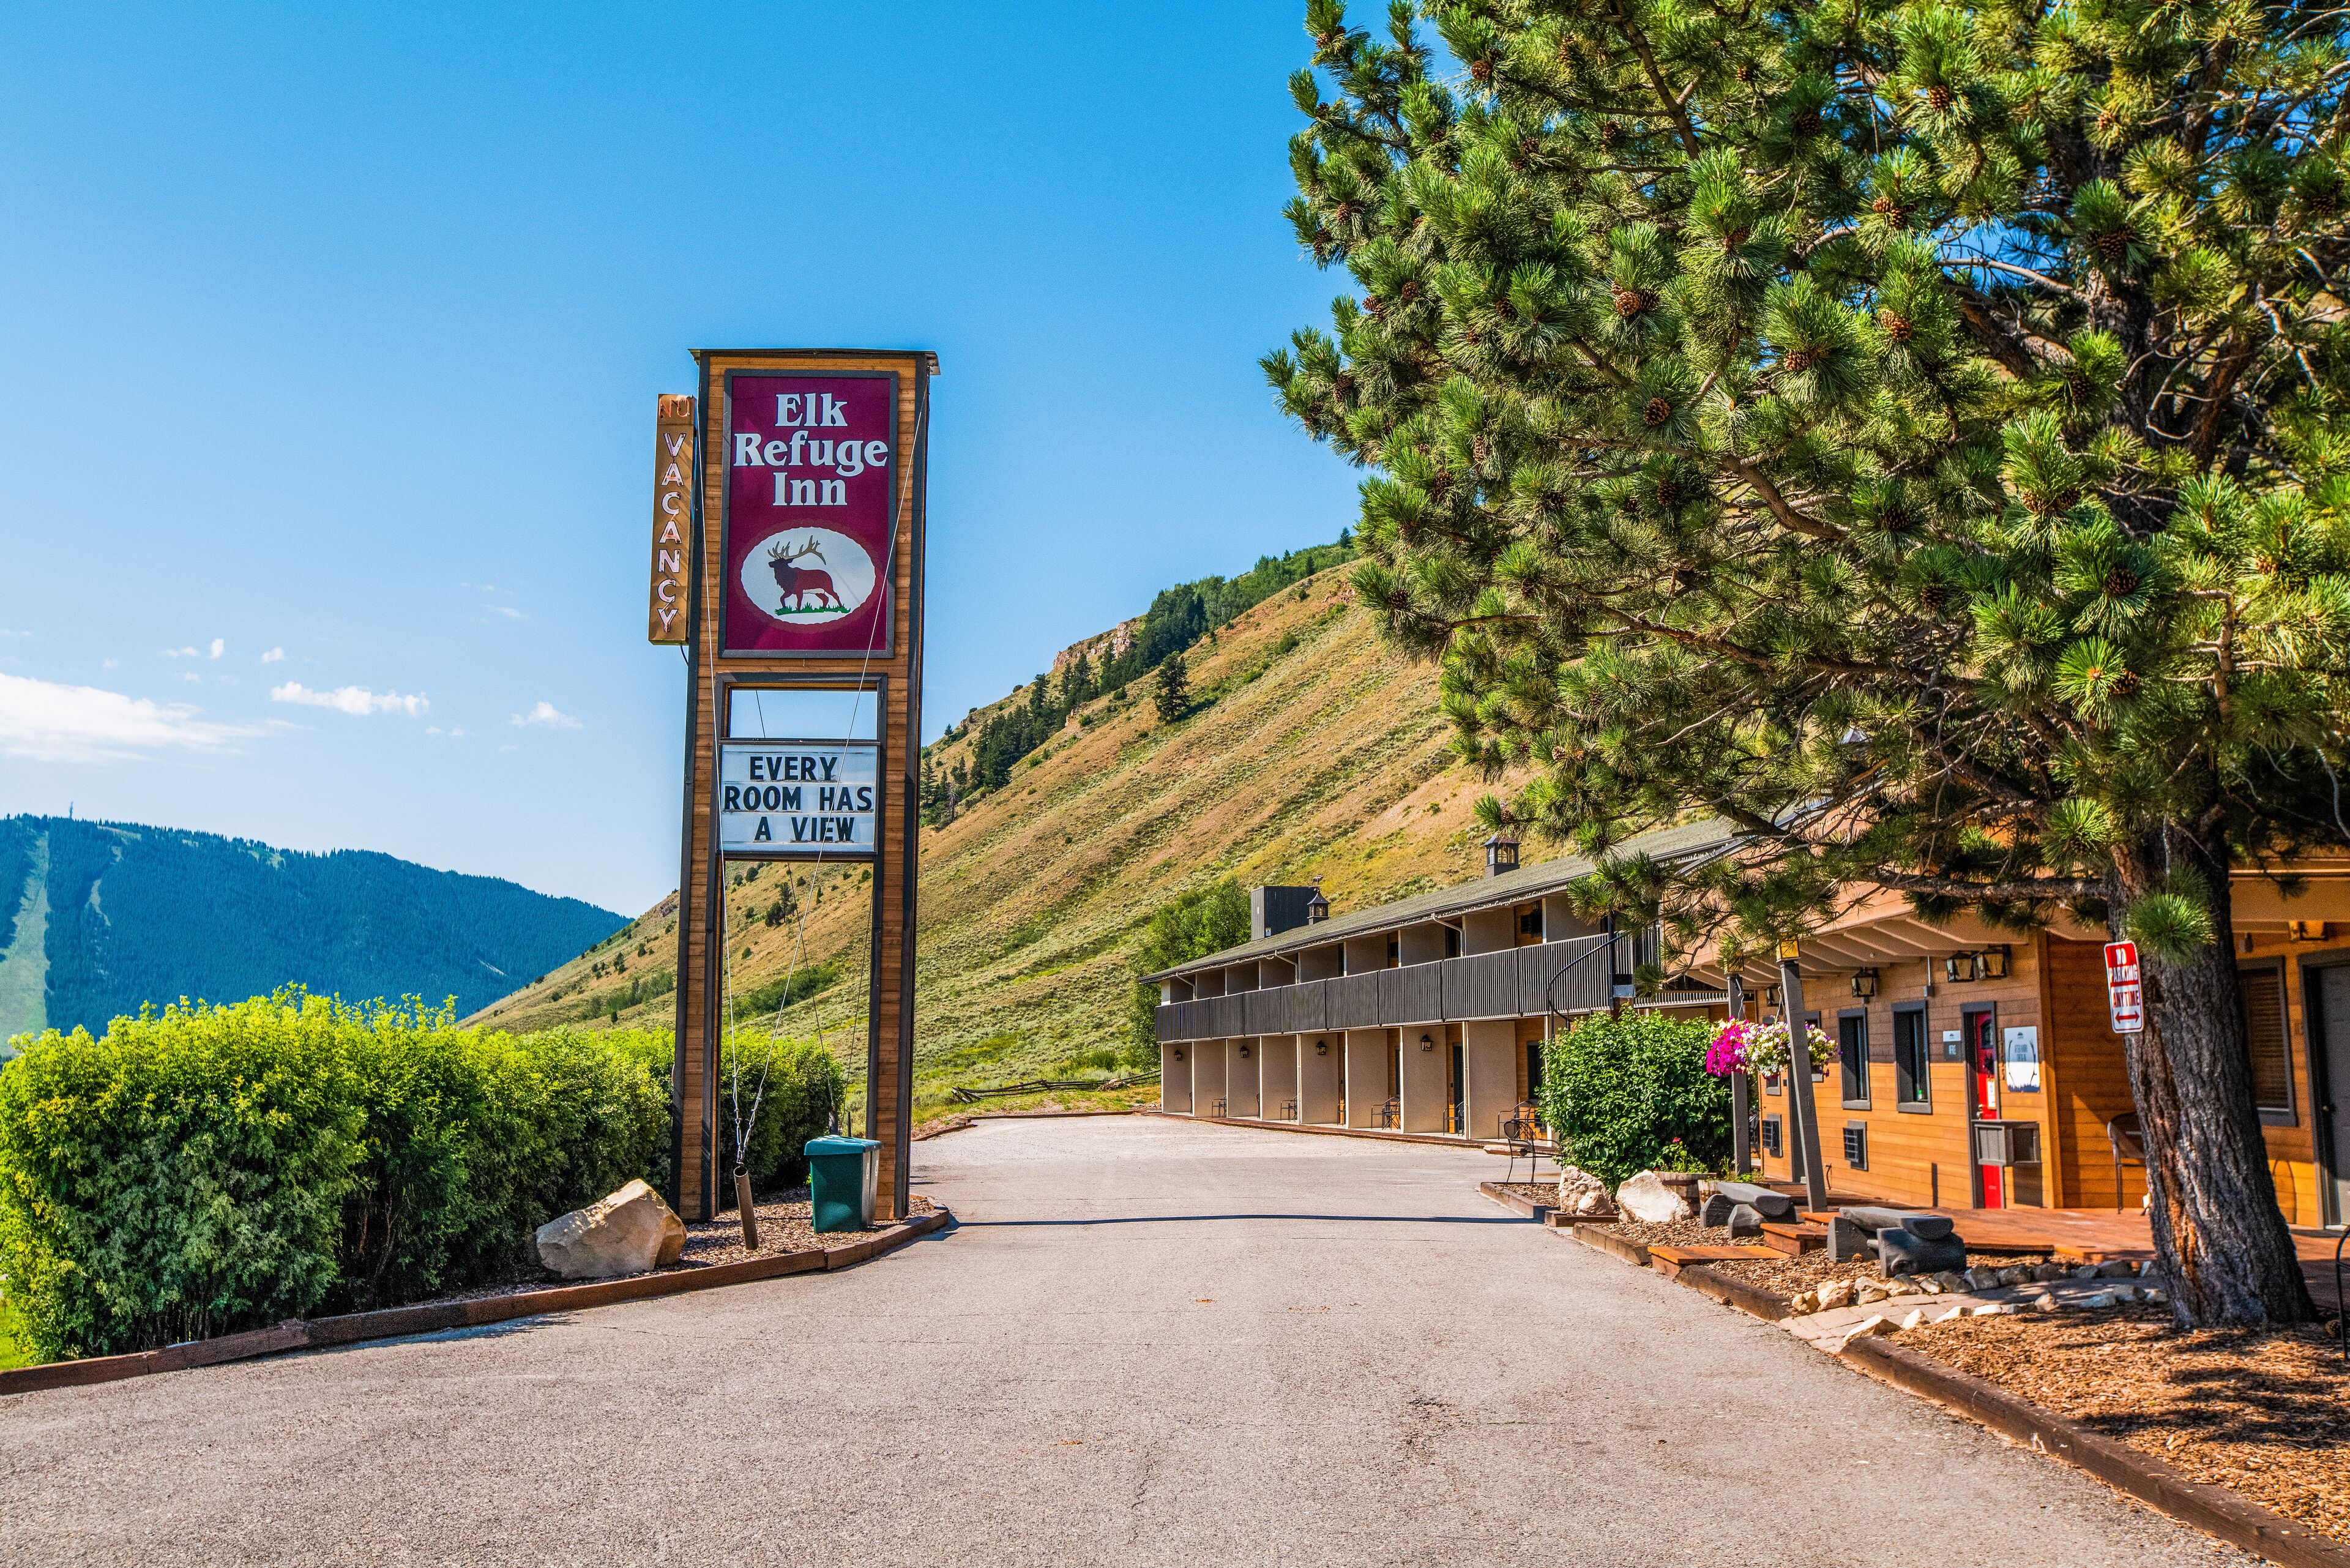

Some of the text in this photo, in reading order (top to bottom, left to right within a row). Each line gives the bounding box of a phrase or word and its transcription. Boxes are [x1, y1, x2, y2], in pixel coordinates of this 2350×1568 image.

[658, 398, 690, 417] NO
[774, 392, 848, 427] Elk
[733, 430, 889, 477] Refuge
[772, 471, 848, 506] Inn
[657, 432, 687, 632] VACANCY
[750, 756, 838, 780] EVERY
[724, 785, 873, 812] ROOM HAS
[753, 816, 855, 842] A VIEW
[2115, 947, 2127, 965] NO
[2108, 964, 2138, 983] PARKING
[2113, 990, 2140, 1008] ANYTIME
